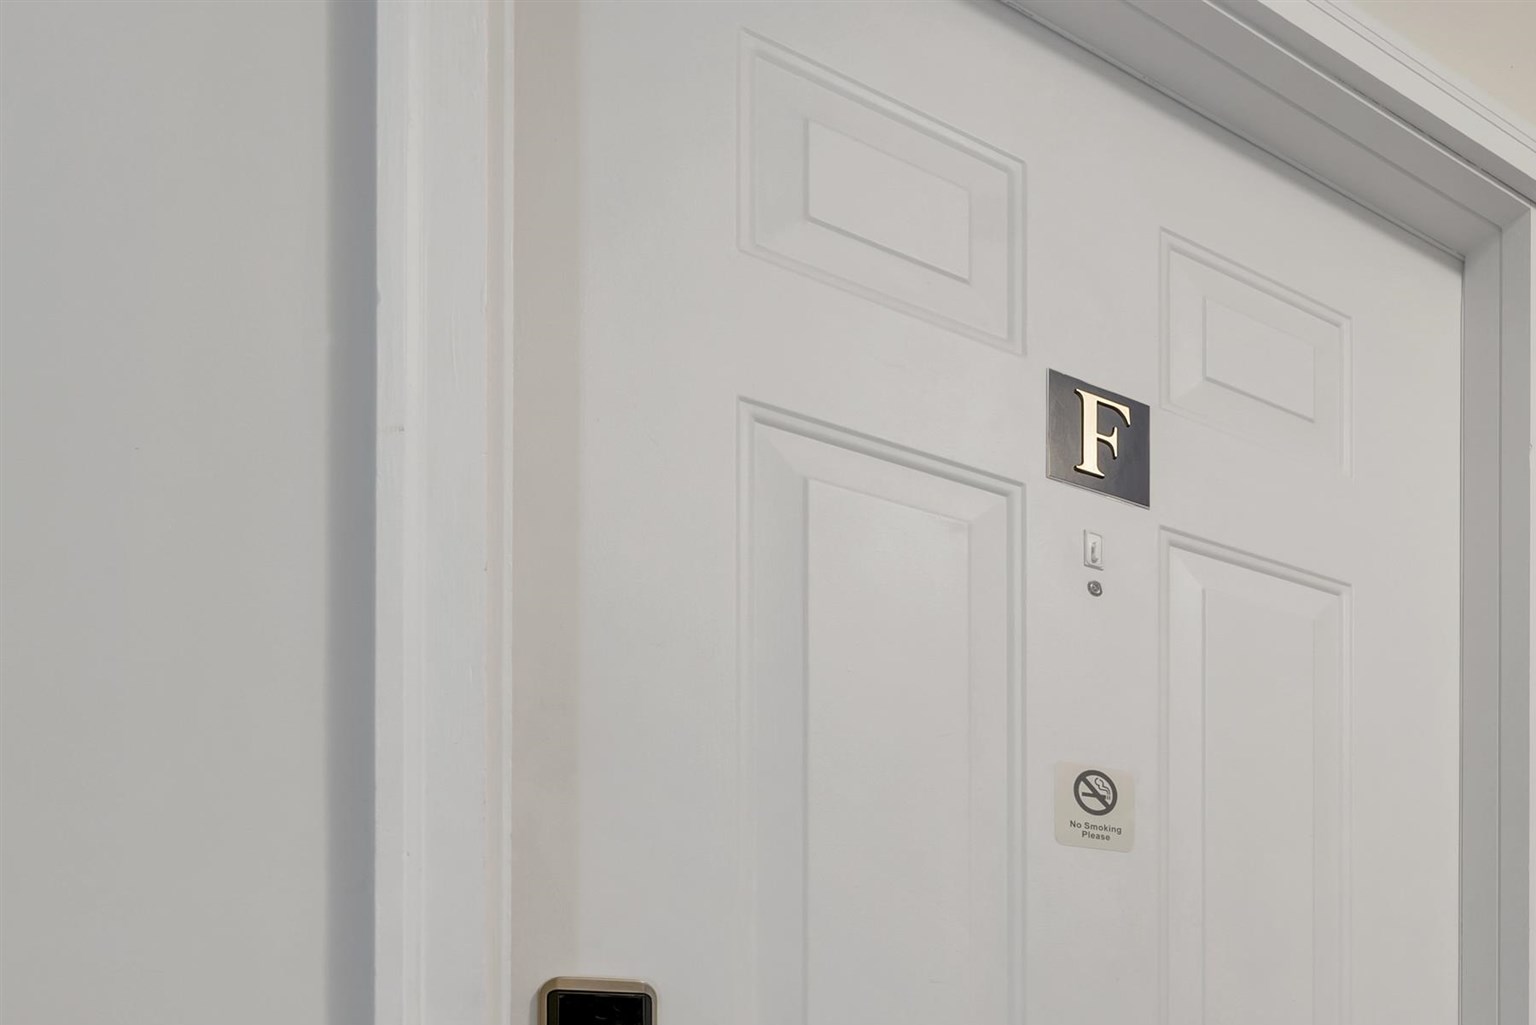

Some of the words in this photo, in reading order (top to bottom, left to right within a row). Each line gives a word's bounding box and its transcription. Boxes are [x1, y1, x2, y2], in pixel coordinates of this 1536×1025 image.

[1073, 388, 1131, 479] F
[1070, 820, 1082, 829] No
[1084, 821, 1122, 835] Smoking
[1081, 830, 1111, 841] Please
